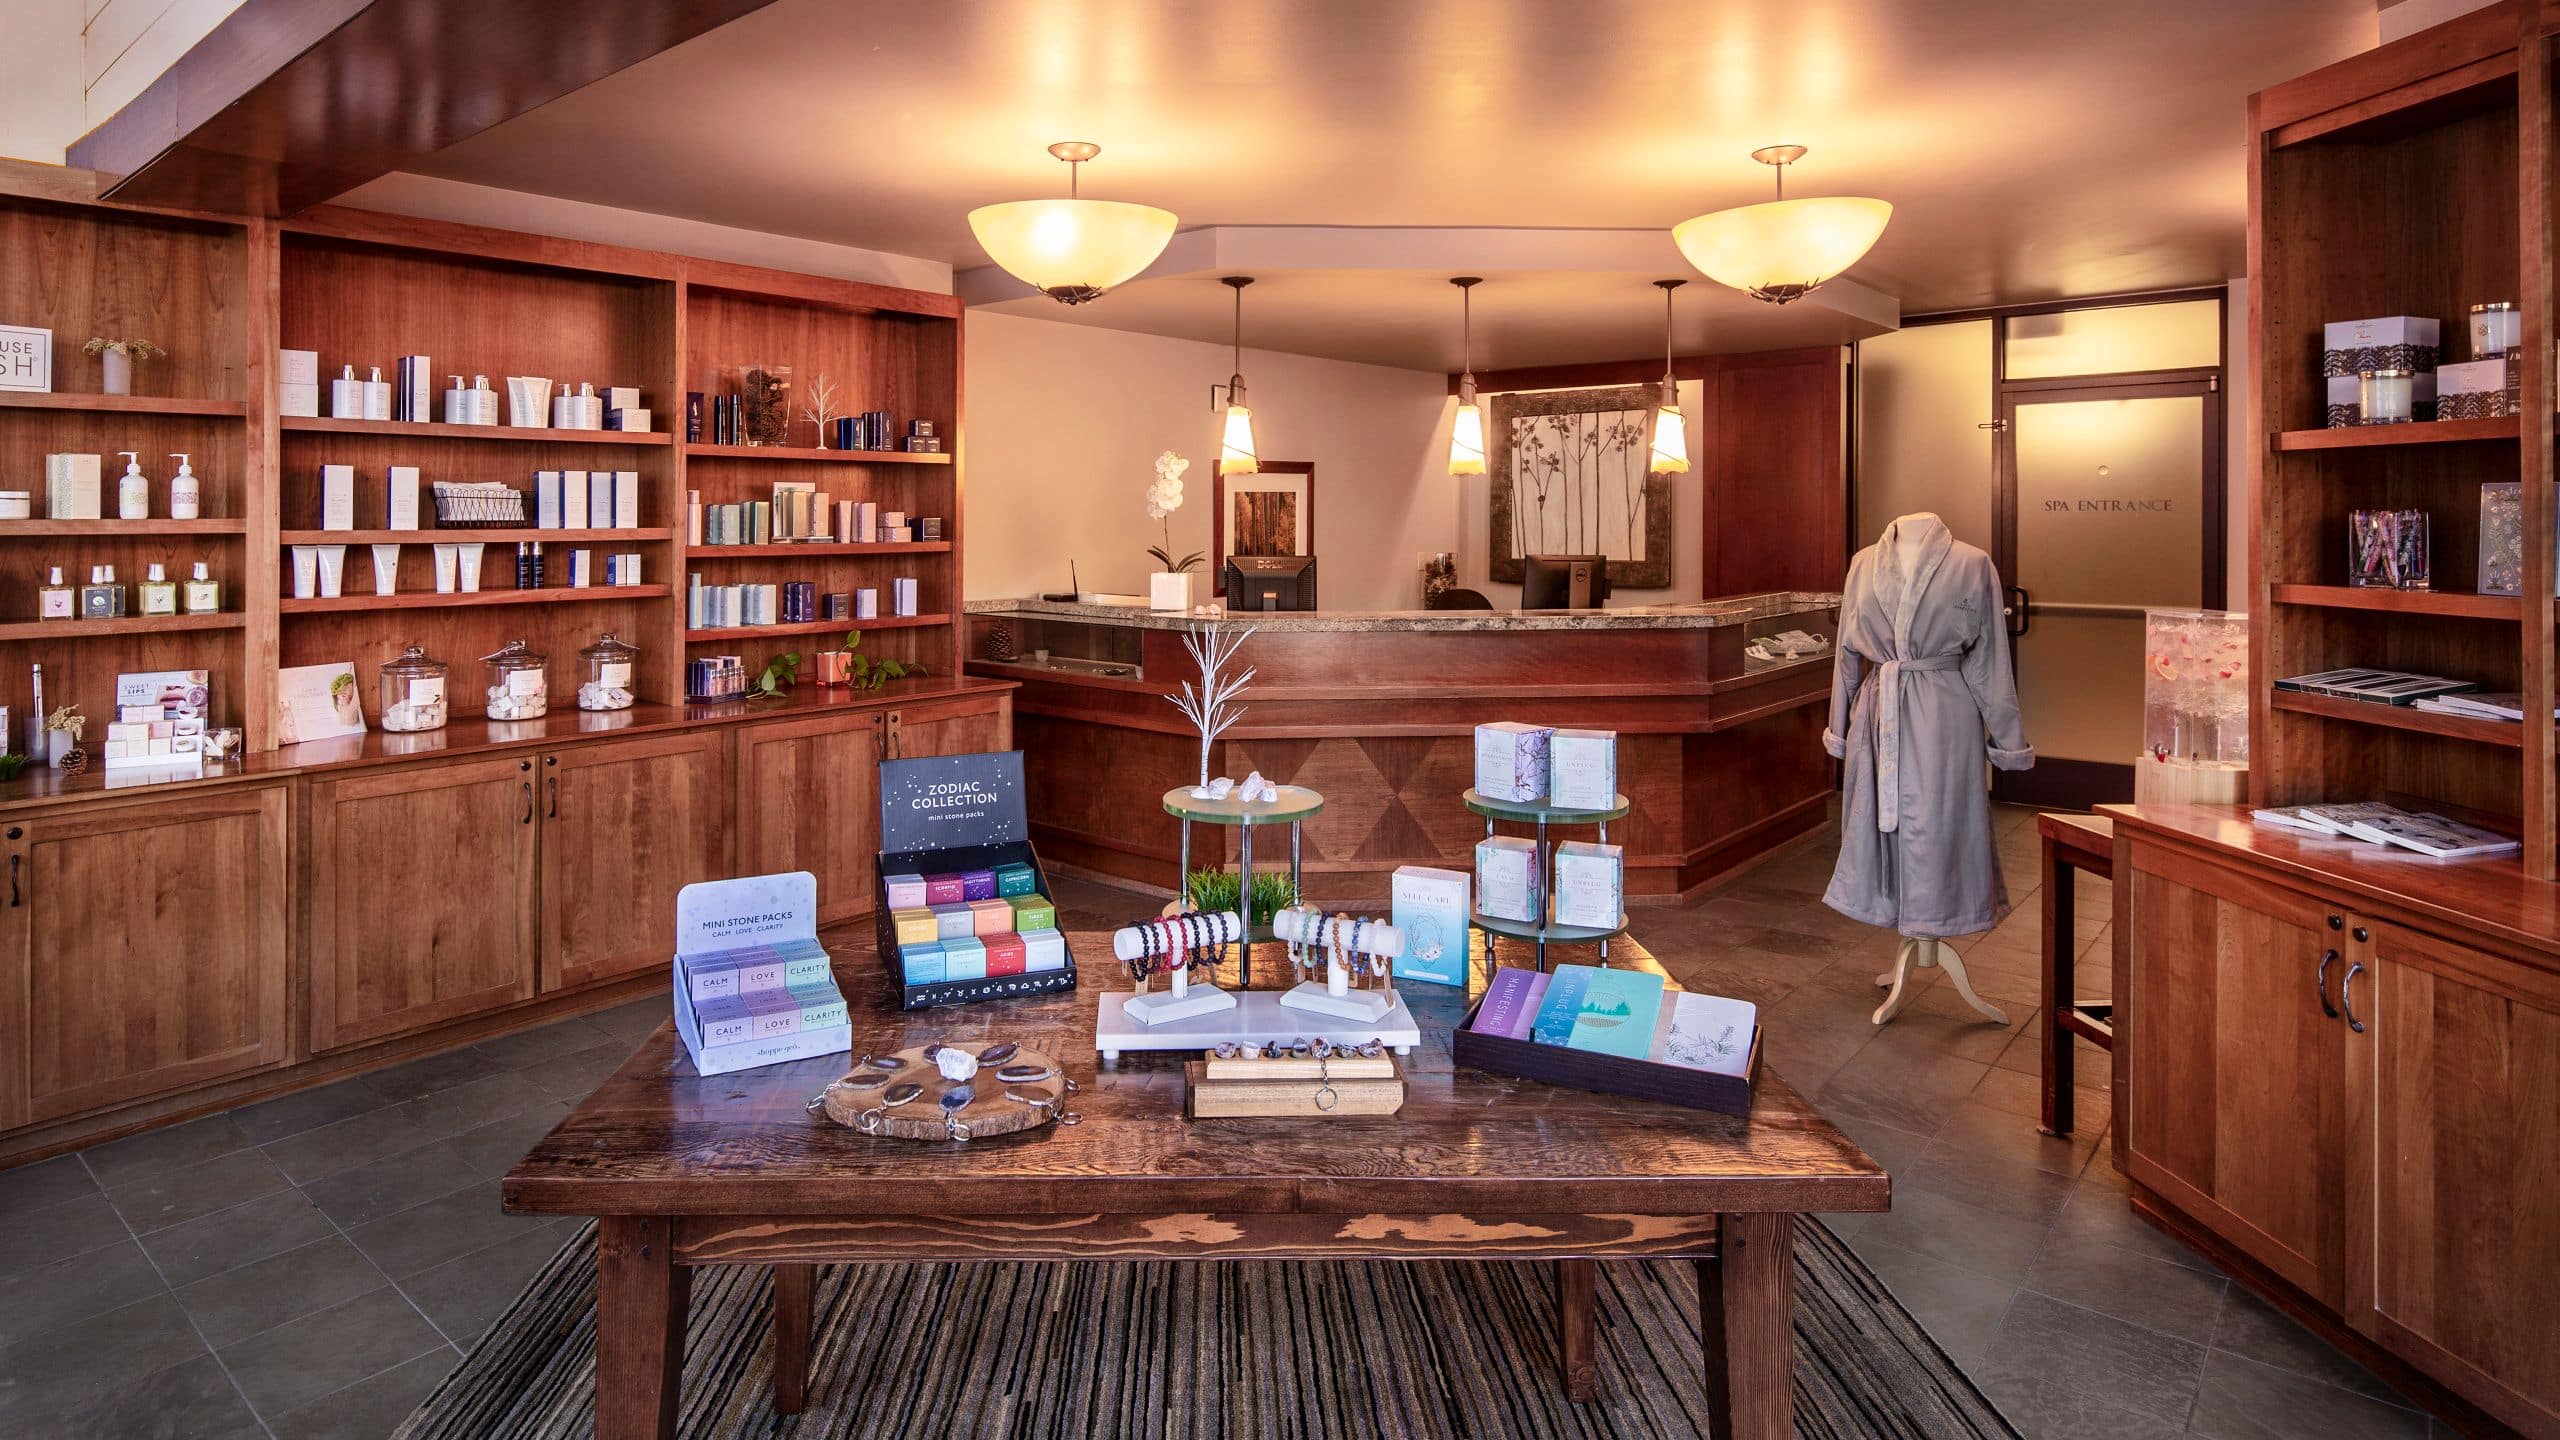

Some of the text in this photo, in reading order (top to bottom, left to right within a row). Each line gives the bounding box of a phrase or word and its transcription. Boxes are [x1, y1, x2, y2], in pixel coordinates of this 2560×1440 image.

[0, 341, 32, 354] USE
[2044, 500, 2173, 512] SPA ENTRANCE
[928, 781, 980, 796] ZODIAC
[912, 792, 998, 810] COLLECTION
[965, 810, 984, 818] packs
[702, 911, 793, 930] MINI STONE PACKS
[712, 923, 783, 938] CALM LOVE CLARITY
[790, 964, 826, 975] CLARITY
[703, 977, 728, 987] CALM
[751, 971, 775, 981] LOVE
[804, 1010, 843, 1022] CLARITY
[764, 1018, 791, 1029] LOVE
[715, 1025, 742, 1036] CALM
